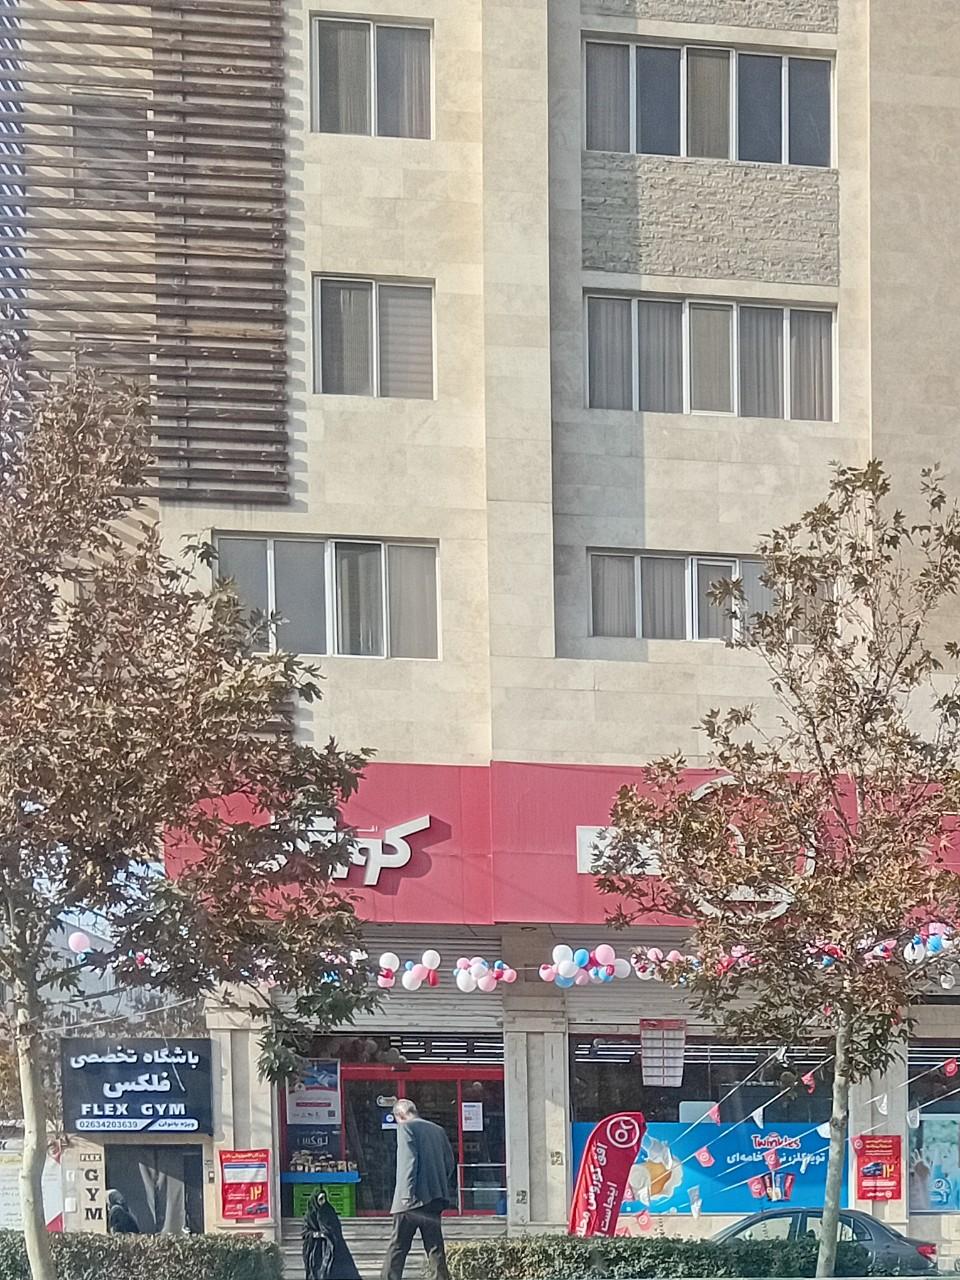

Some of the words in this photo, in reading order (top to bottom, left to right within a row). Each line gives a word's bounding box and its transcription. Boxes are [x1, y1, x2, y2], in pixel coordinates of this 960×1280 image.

[70, 1046, 138, 1069] تخصصی
[142, 1046, 199, 1069] باشگاه
[103, 1071, 171, 1098] فلکس
[81, 1103, 128, 1115] FLEX
[141, 1103, 186, 1115] GYM
[79, 1120, 138, 1128] 02634203639
[592, 1140, 608, 1166] افق
[583, 1164, 603, 1210] کوروش
